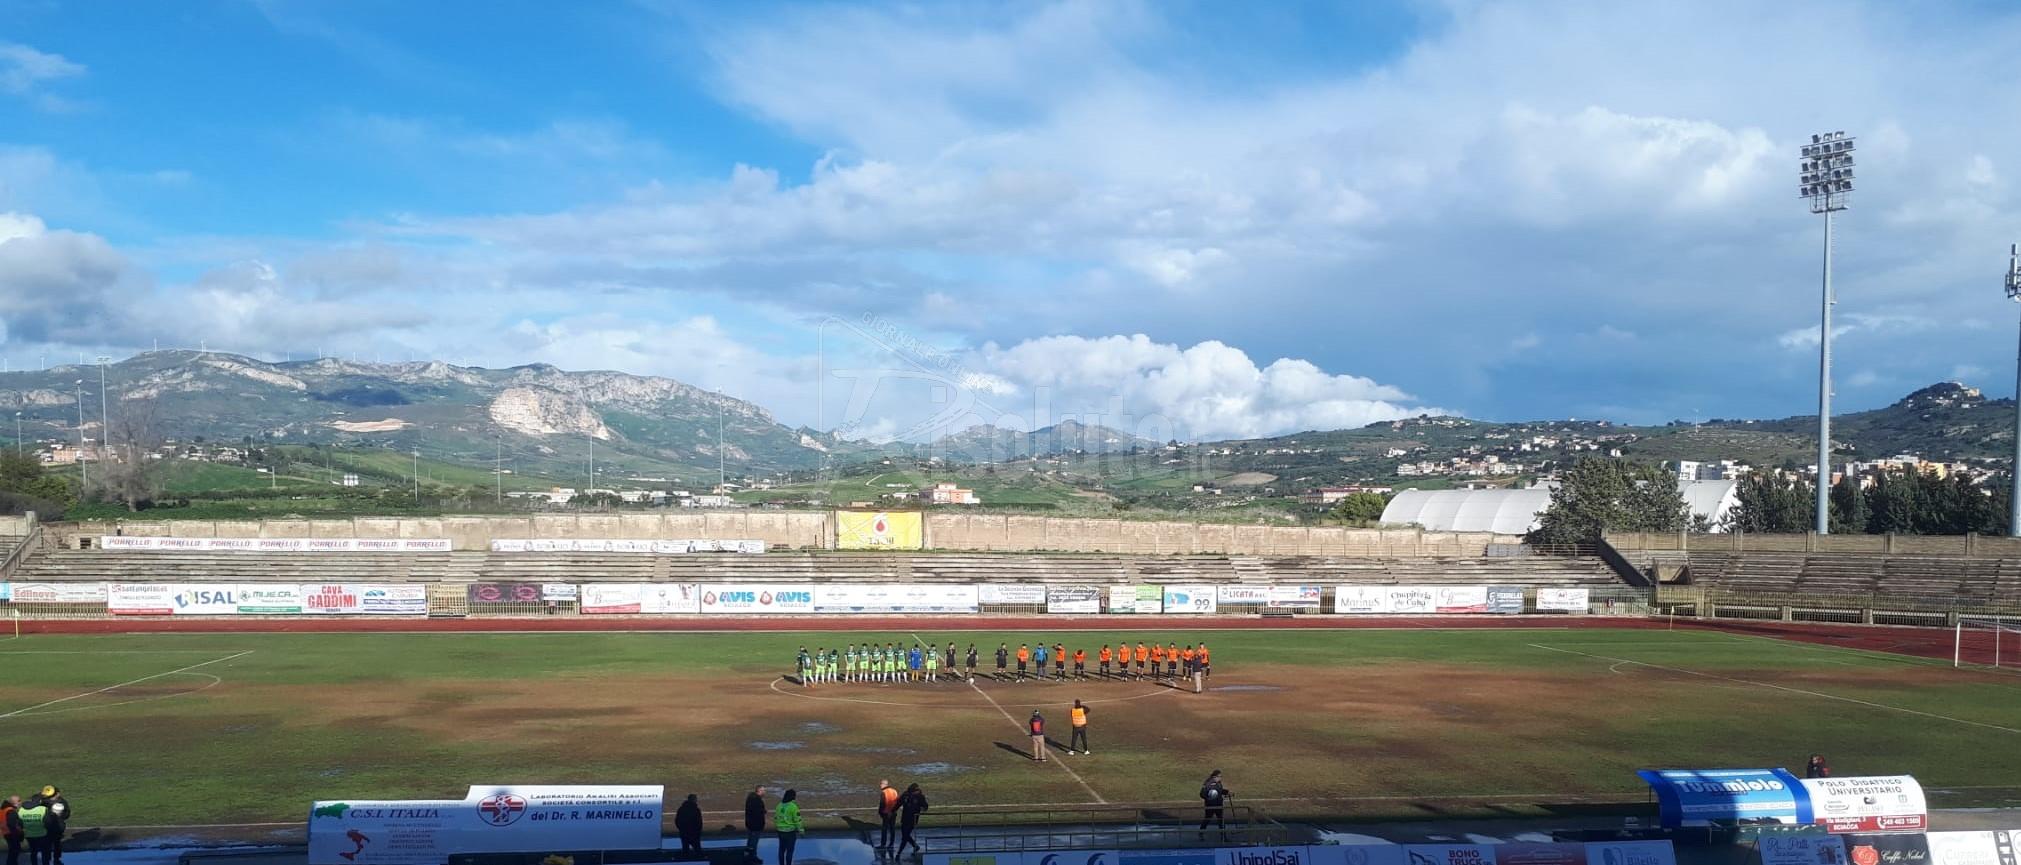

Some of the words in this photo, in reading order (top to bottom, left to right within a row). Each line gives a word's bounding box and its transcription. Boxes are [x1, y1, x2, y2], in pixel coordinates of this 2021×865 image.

[321, 585, 343, 594] CAVA
[194, 591, 236, 604] ISAL
[720, 591, 755, 602] AVIS
[775, 591, 811, 602] AVIS
[1676, 779, 1785, 792] Tummiolo
[350, 808, 384, 818] C.S.I.
[389, 808, 439, 818] ITALIA
[531, 811, 548, 821] del
[552, 812, 566, 820] Dr.
[586, 810, 653, 820] MARINELLO
[1231, 850, 1299, 865] UnipolSai
